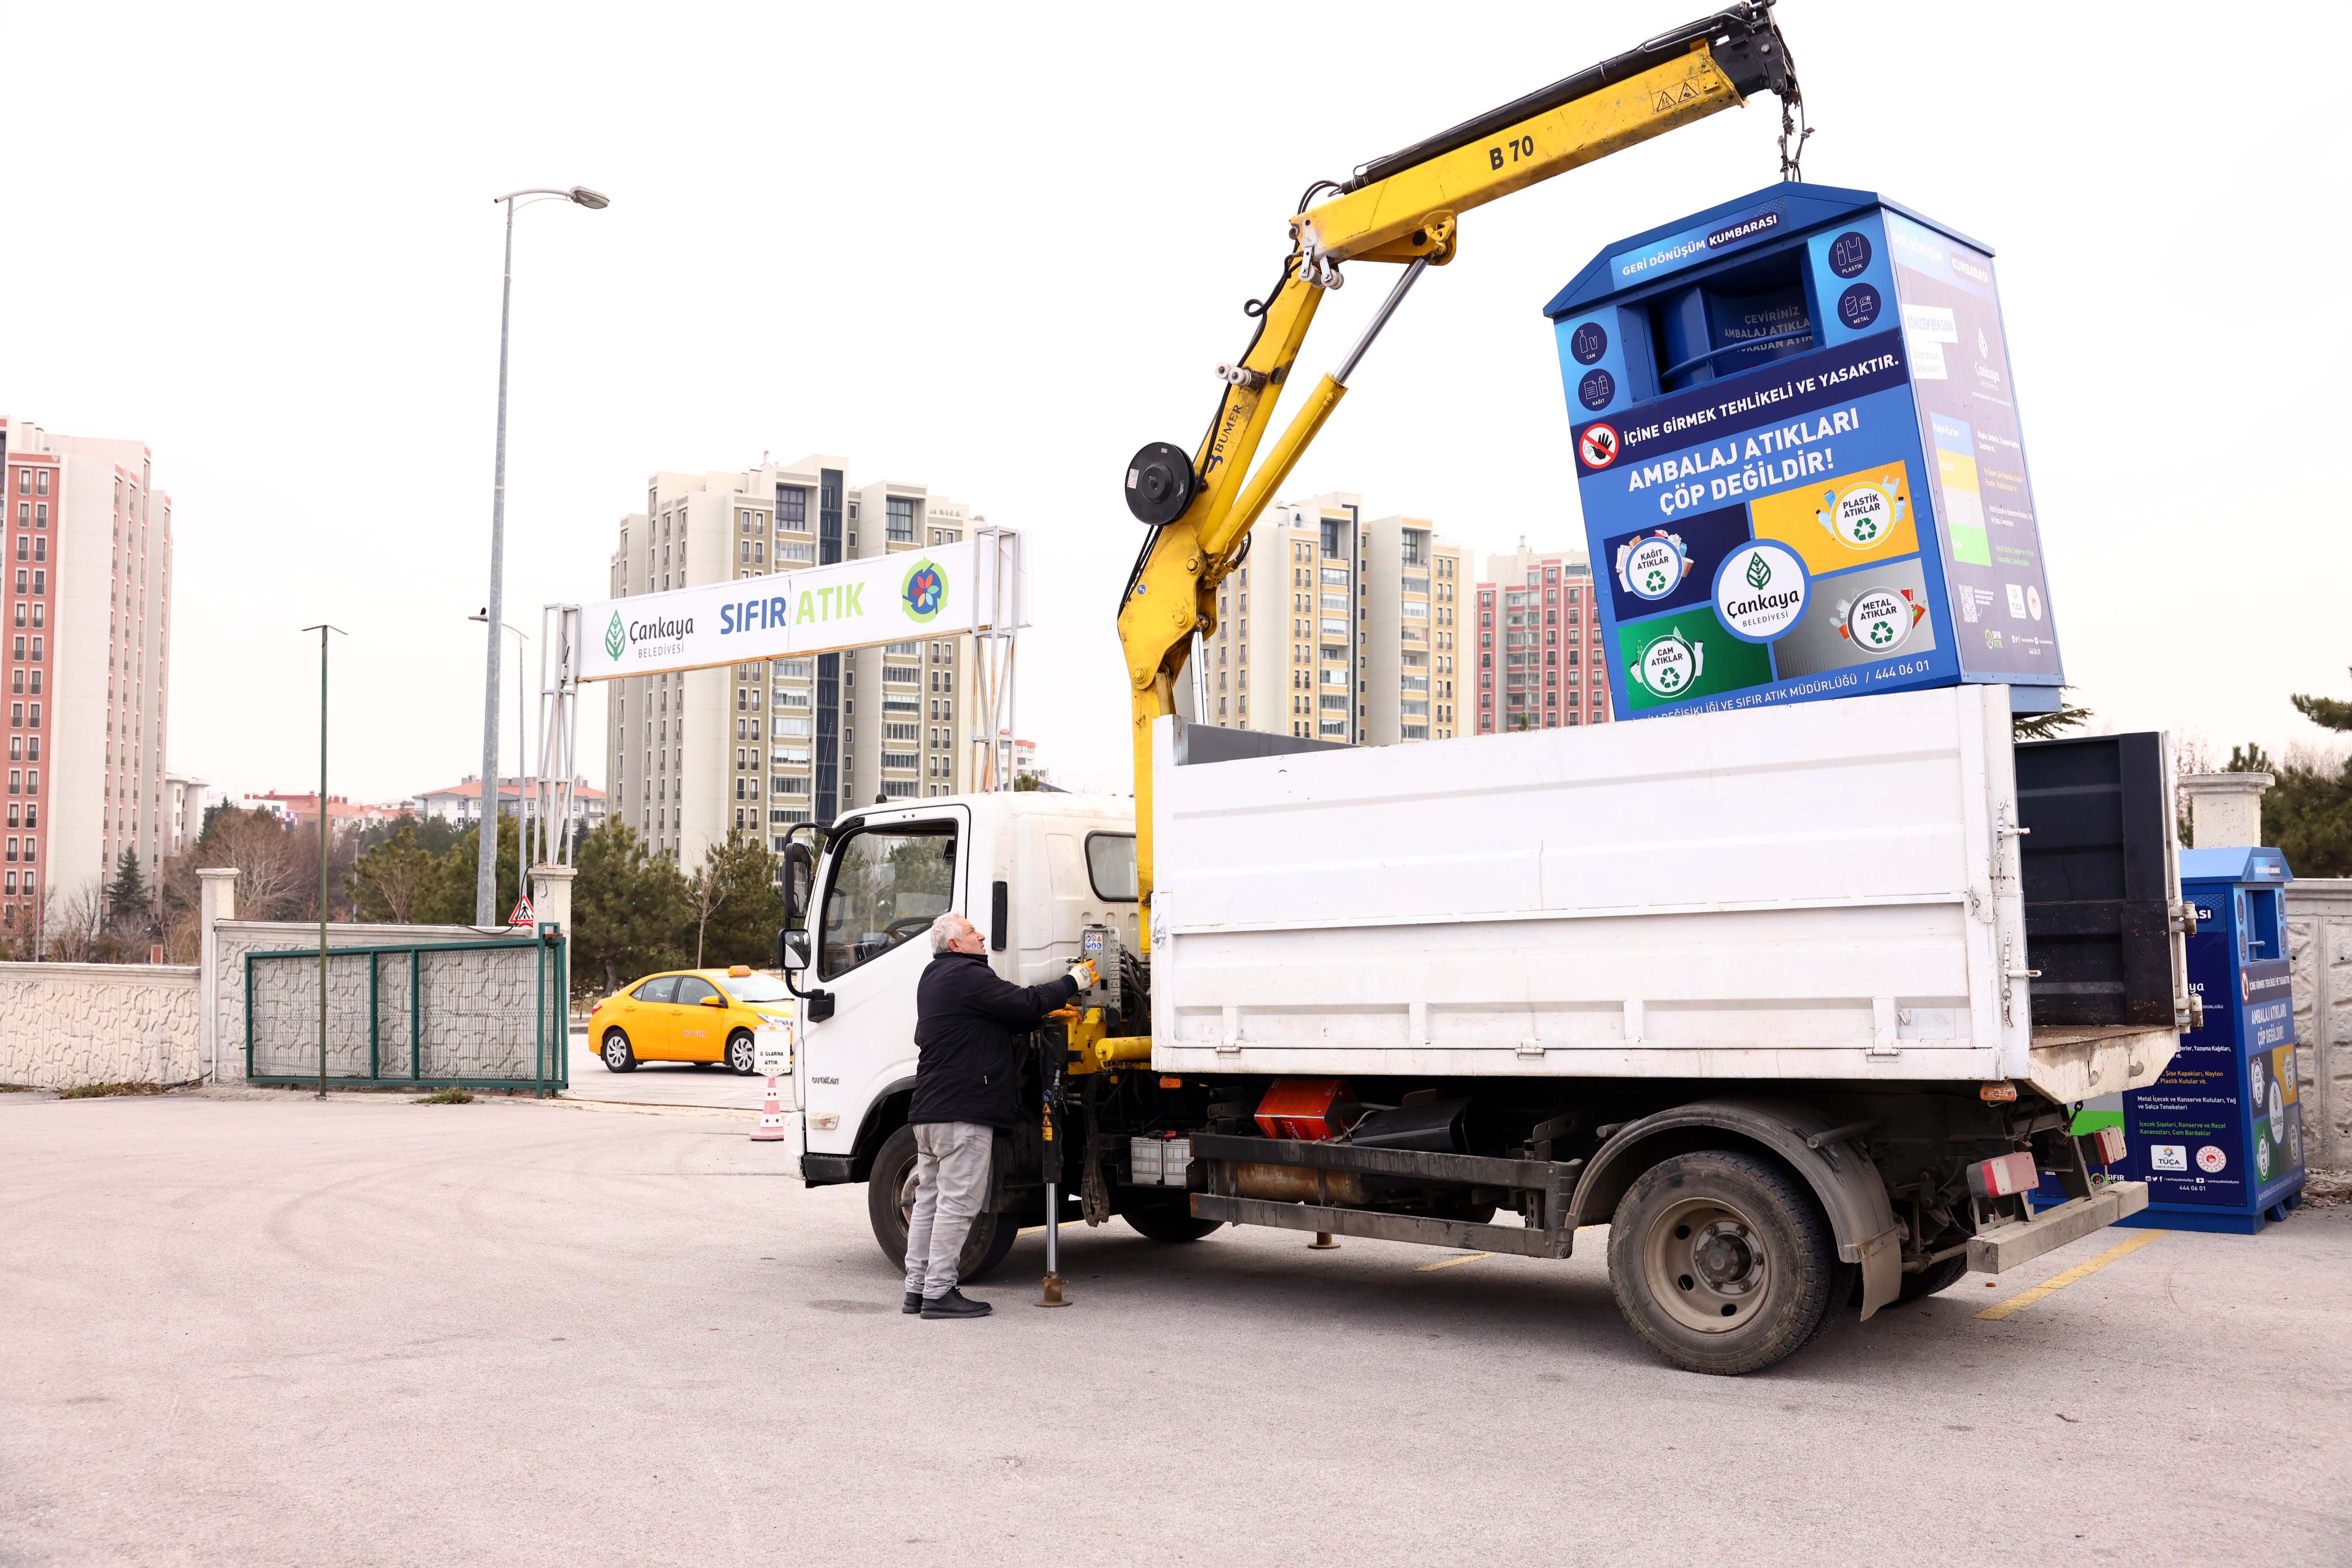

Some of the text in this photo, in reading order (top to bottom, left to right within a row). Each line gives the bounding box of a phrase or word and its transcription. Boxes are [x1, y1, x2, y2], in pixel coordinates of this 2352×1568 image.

[1489, 135, 1534, 171] B 70
[1622, 215, 1778, 276] GERİ DÖNÜŞÜM KUMBARASI
[1842, 263, 1863, 274] PLASTİK
[1950, 256, 1989, 284] KUMBARASI
[1745, 306, 1799, 325] ÇEVİRİNİZ
[1854, 315, 1869, 324] METAL
[1725, 318, 1810, 338] AMBALAJ ATIKLA
[1975, 362, 1999, 382] Çankaya
[1624, 426, 1660, 447] İÇİNE
[1663, 407, 1716, 434] GİRMEK
[1718, 381, 1793, 417] TEHLİKELİ
[1797, 377, 1816, 394] VE
[1818, 353, 1900, 386] YASAKTIR.
[1214, 404, 1242, 453] BUMER
[1628, 407, 1860, 492] AMBALAJ ATIKLARI
[1659, 447, 1834, 516] ÇÖP DEĞİLDİR!
[1843, 493, 1879, 509] PLASTİK
[1843, 502, 1881, 518] ATIKLAR
[1637, 555, 1669, 570] ATIKLAR
[1640, 549, 1663, 562] KAĞIT
[720, 582, 866, 635] SIFIR ATIK
[1726, 590, 1799, 619] Çankaya
[1860, 606, 1897, 621] ATIKLAR
[1863, 599, 1892, 611] METAL
[1743, 610, 1789, 627] BELEDİYESİ
[630, 617, 693, 644] Çankaya
[638, 642, 684, 658] BELEDİYESİ
[1651, 652, 1683, 667] ATIKLAR
[1657, 646, 1674, 657] CAM
[1721, 700, 1735, 710] VE
[1736, 694, 1762, 710] SIFIR
[1765, 689, 1787, 704] ATIK
[1790, 674, 1857, 697] MÜDÜRLÜĞÜ
[1865, 671, 1870, 683] /
[1875, 666, 1896, 680] 444
[1899, 663, 1914, 677] 06
[1916, 660, 1930, 672] 01
[2252, 1003, 2287, 1025] AMBALAJ ATIKLARI
